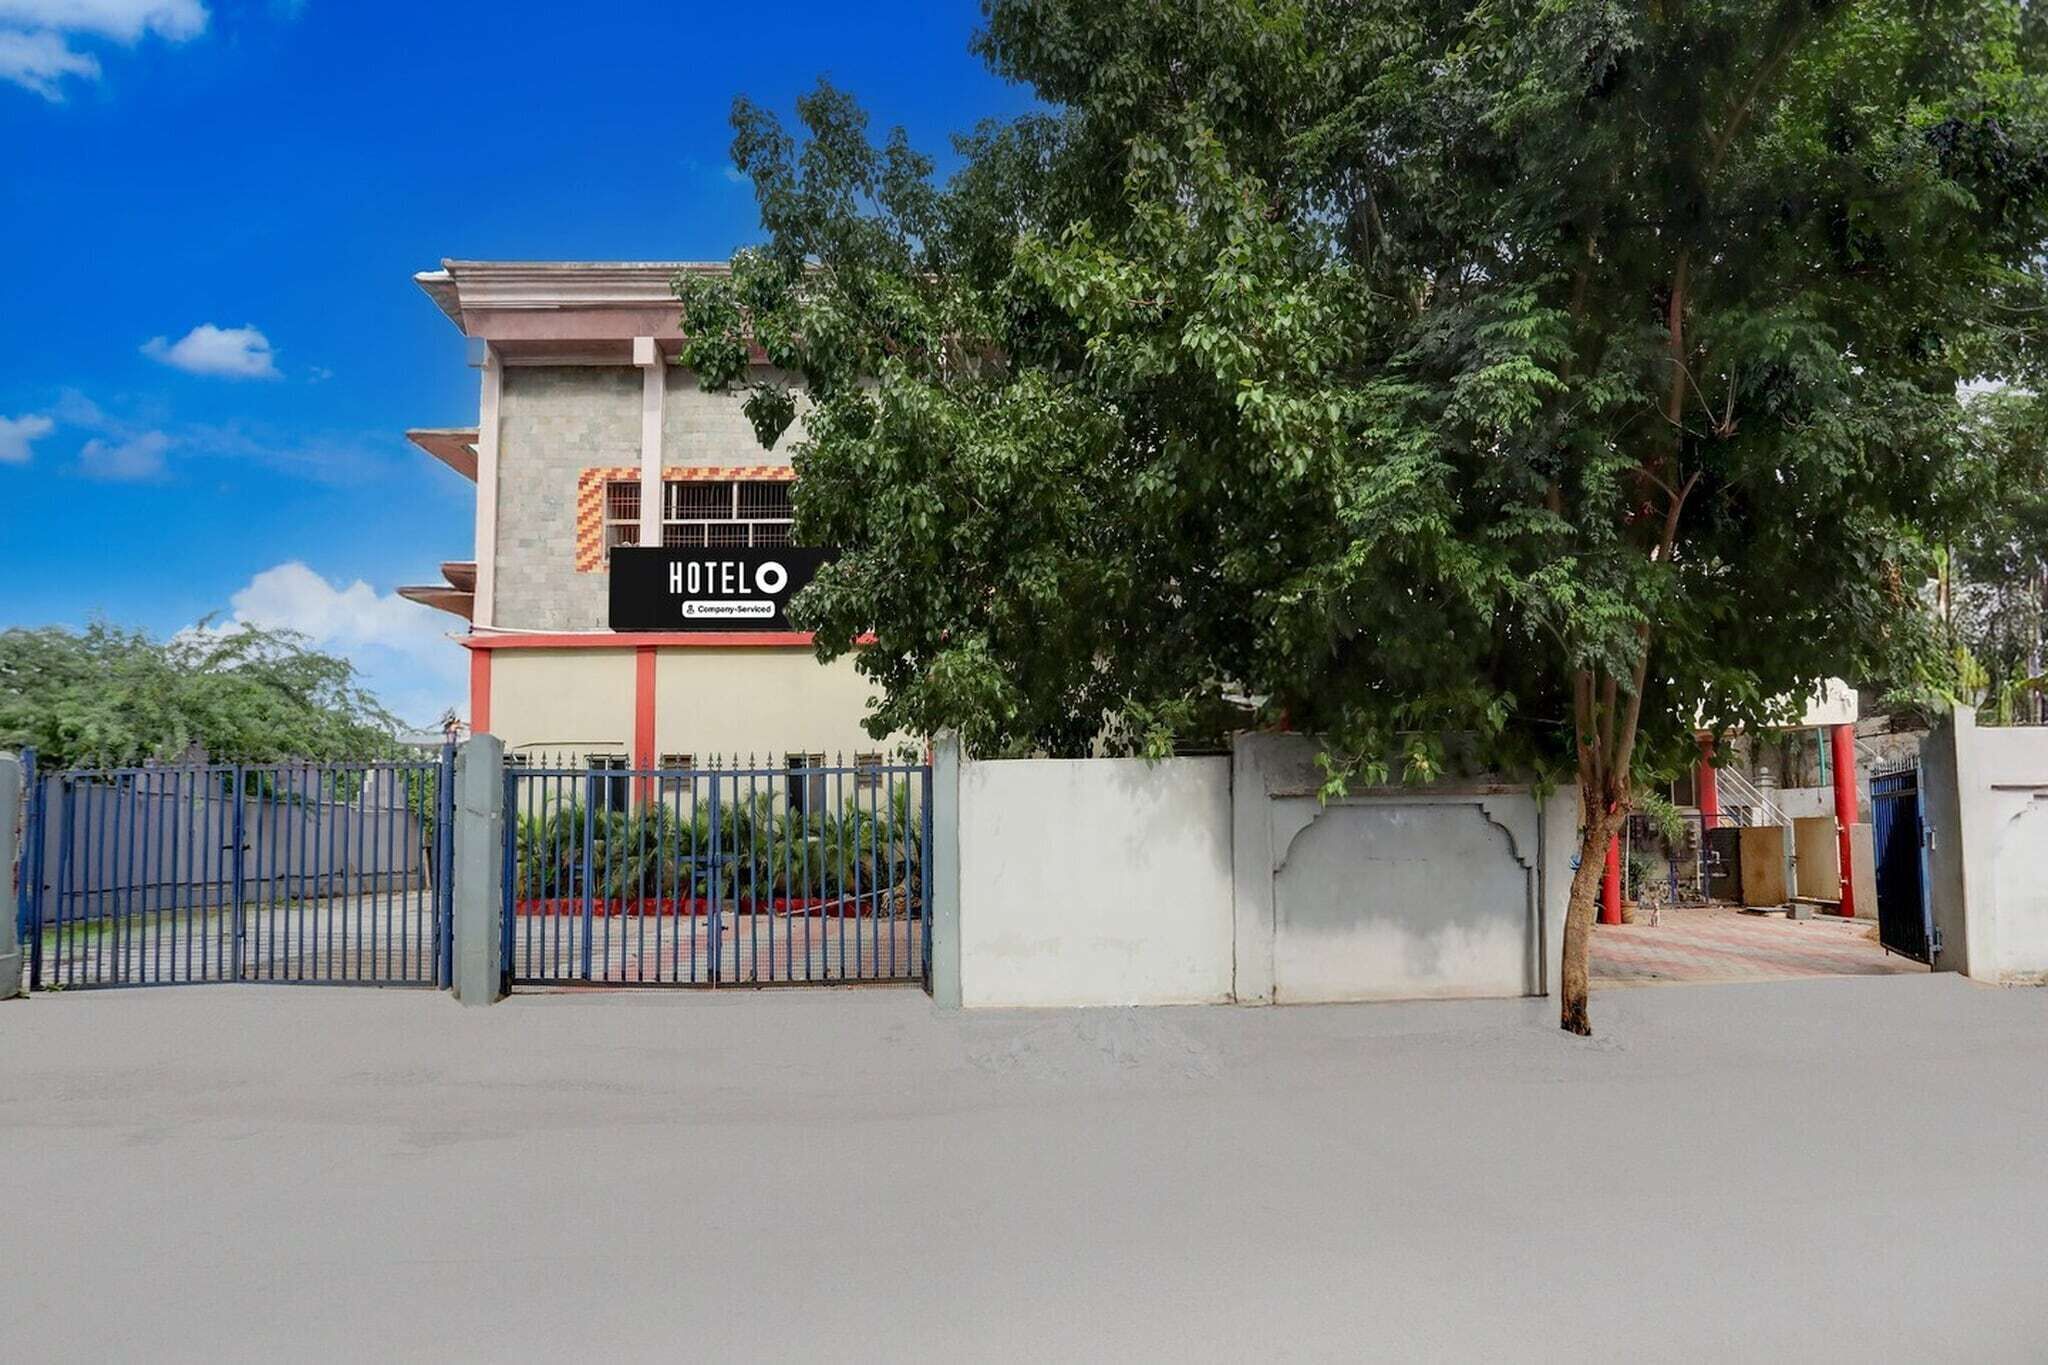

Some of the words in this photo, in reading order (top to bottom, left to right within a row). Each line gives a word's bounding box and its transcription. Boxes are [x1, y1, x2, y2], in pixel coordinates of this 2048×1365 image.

[669, 561, 752, 594] HOTEL
[755, 561, 788, 594] O
[697, 605, 772, 615] Company-Serviced
